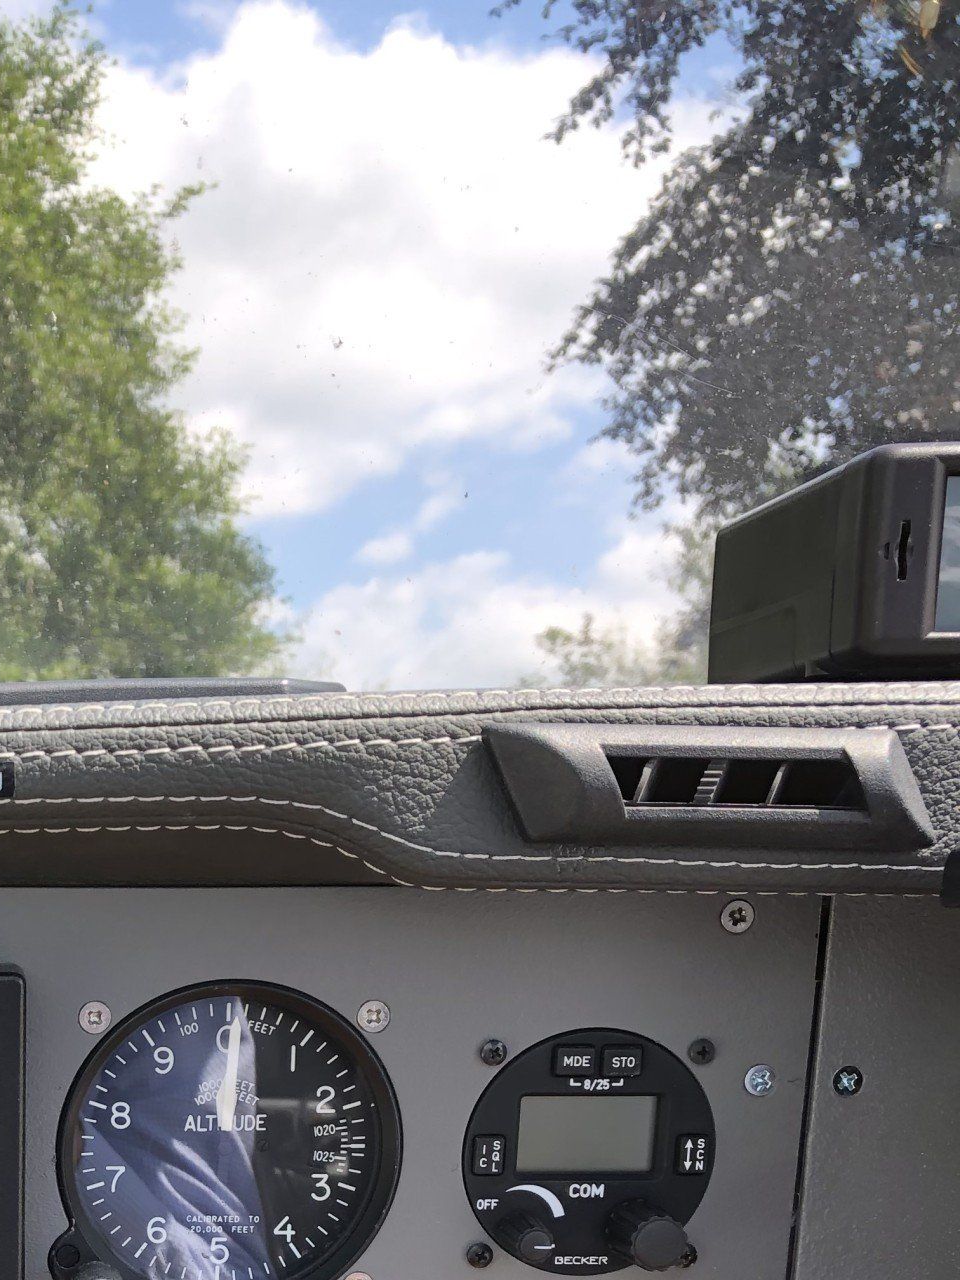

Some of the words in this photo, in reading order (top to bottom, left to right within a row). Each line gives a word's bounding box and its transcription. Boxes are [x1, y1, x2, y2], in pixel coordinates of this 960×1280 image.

[180, 1022, 199, 1037] 100
[247, 1020, 276, 1036] FEET
[153, 1047, 175, 1074] 9
[290, 1045, 296, 1072] 1
[563, 1056, 591, 1067] MDE
[612, 1057, 636, 1068] STO
[583, 1079, 610, 1091] 8/25
[315, 1085, 336, 1113] 2
[111, 1102, 131, 1129] 8
[184, 1114, 267, 1132] ALTUDE
[313, 1124, 336, 1137] 1020
[313, 1150, 335, 1163] 1025
[106, 1166, 126, 1192] 7
[311, 1173, 331, 1201] 3
[569, 1183, 605, 1199] COM
[476, 1199, 499, 1210] OFF
[186, 1215, 240, 1223] CALIBRATED
[249, 1215, 260, 1223] TO
[147, 1217, 167, 1243] 6
[273, 1216, 296, 1242] 4
[209, 1238, 229, 1264] 5
[554, 1256, 608, 1265] BECKER
